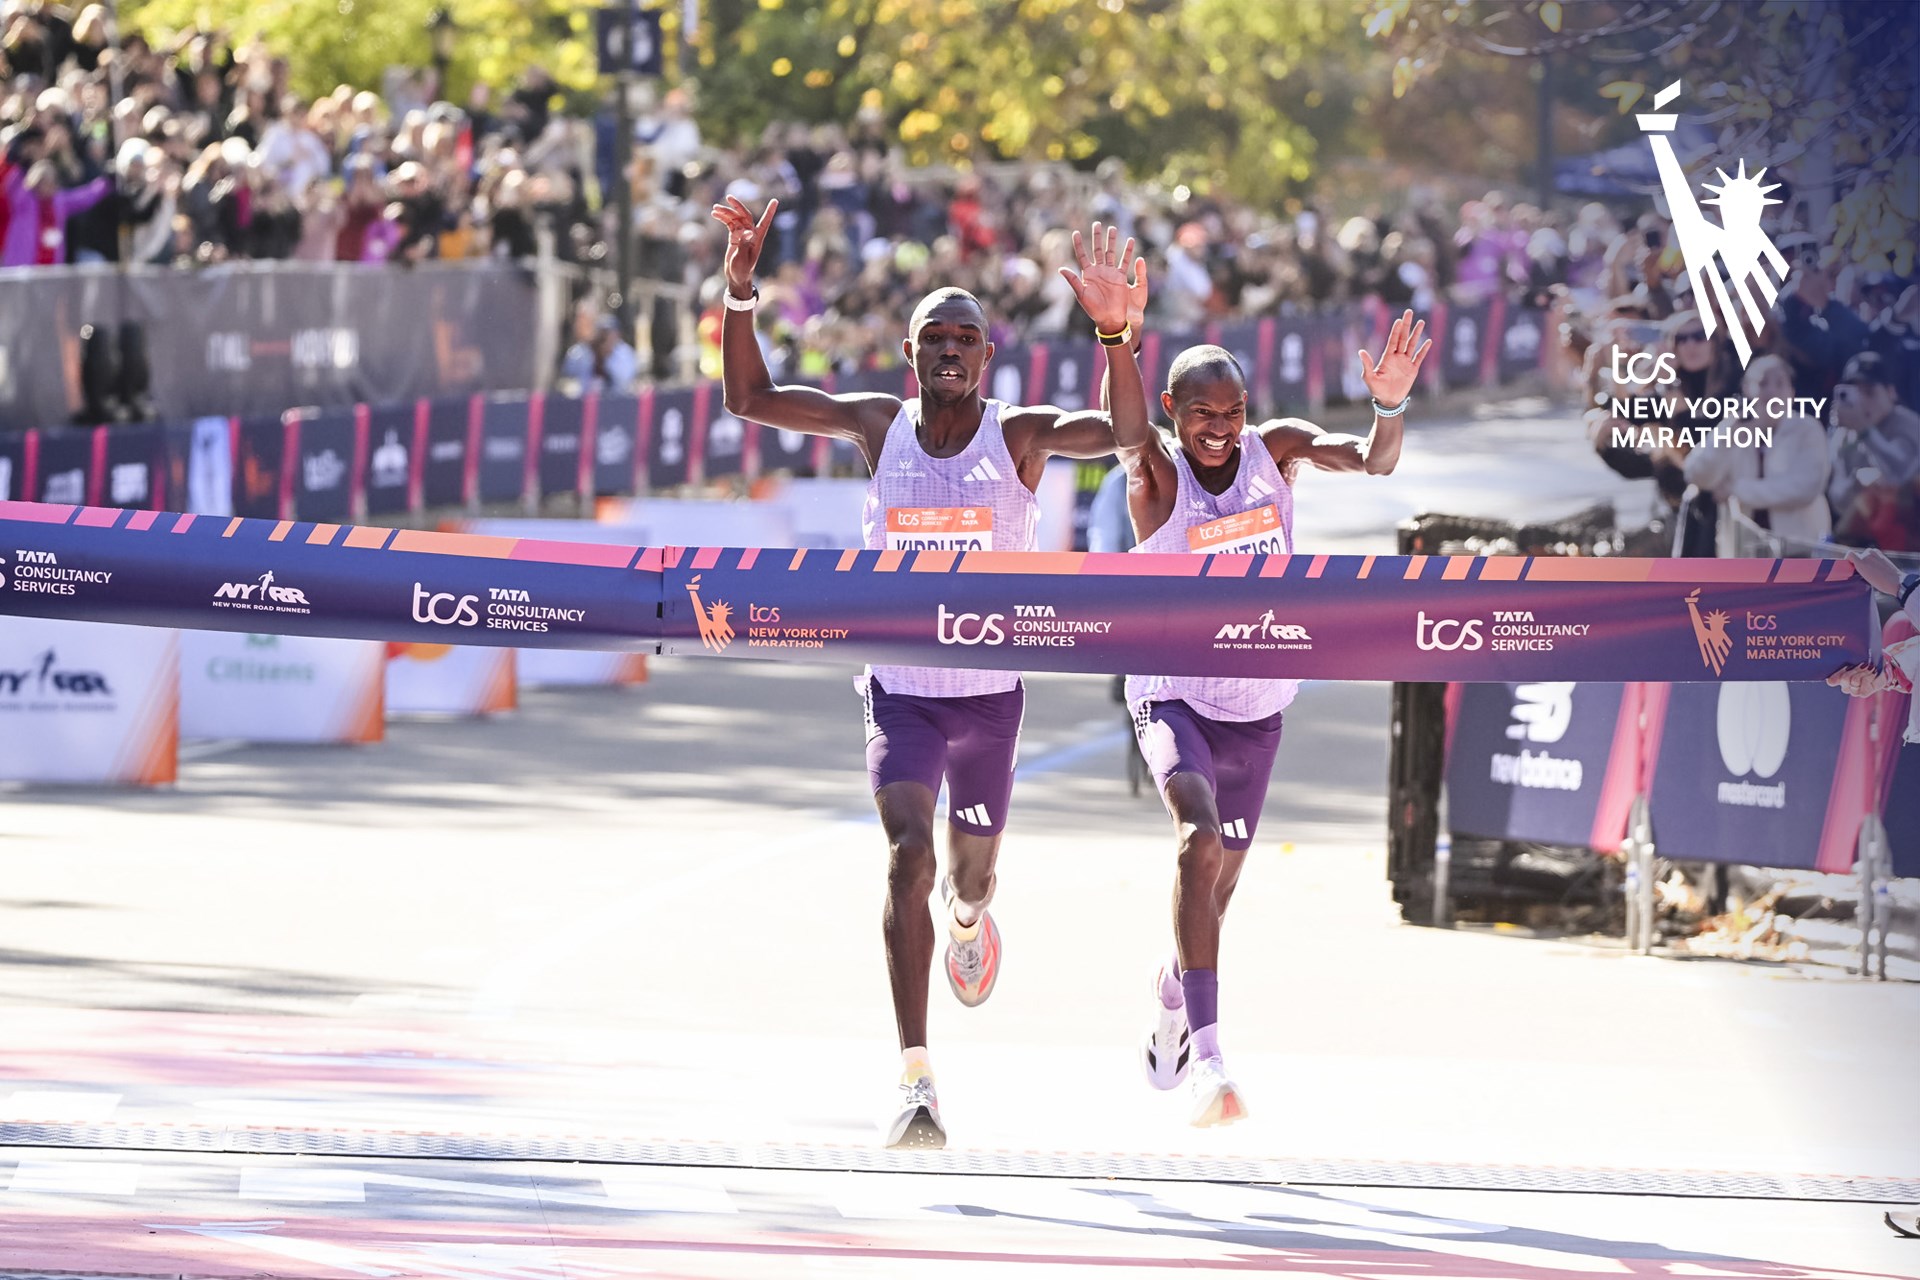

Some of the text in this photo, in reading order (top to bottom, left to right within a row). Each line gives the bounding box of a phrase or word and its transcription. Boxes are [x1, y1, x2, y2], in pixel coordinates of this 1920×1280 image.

[897, 511, 920, 526] tcs
[1199, 524, 1224, 541] tcs
[15, 550, 57, 565] TATA
[14, 565, 113, 584] CONSULTANCY
[13, 580, 76, 596] SERVICES
[488, 588, 531, 602] TATA
[231, 602, 252, 610] YORK
[275, 606, 311, 614] RUNNERS
[412, 582, 480, 626] tcs
[487, 603, 586, 622] CONSULTANCY
[749, 602, 781, 623] tcs
[1013, 605, 1056, 618] TATA
[1492, 611, 1535, 622] TATA
[486, 617, 549, 633] SERVICES
[937, 603, 1005, 646] tcs
[1013, 620, 1112, 634] CONSULTANCY
[1746, 611, 1777, 631] tcs
[749, 627, 849, 640] NEW YORK CITY
[1416, 610, 1484, 651] tcs
[1491, 624, 1591, 637] CONSULTANCY
[748, 639, 824, 649] MARATHON
[1012, 635, 1076, 647] SERVICES
[1232, 642, 1253, 650] YORK
[1491, 639, 1554, 651] SERVICES
[1746, 635, 1846, 646] NEW YORK CITY
[1746, 649, 1821, 660] MARATHON
